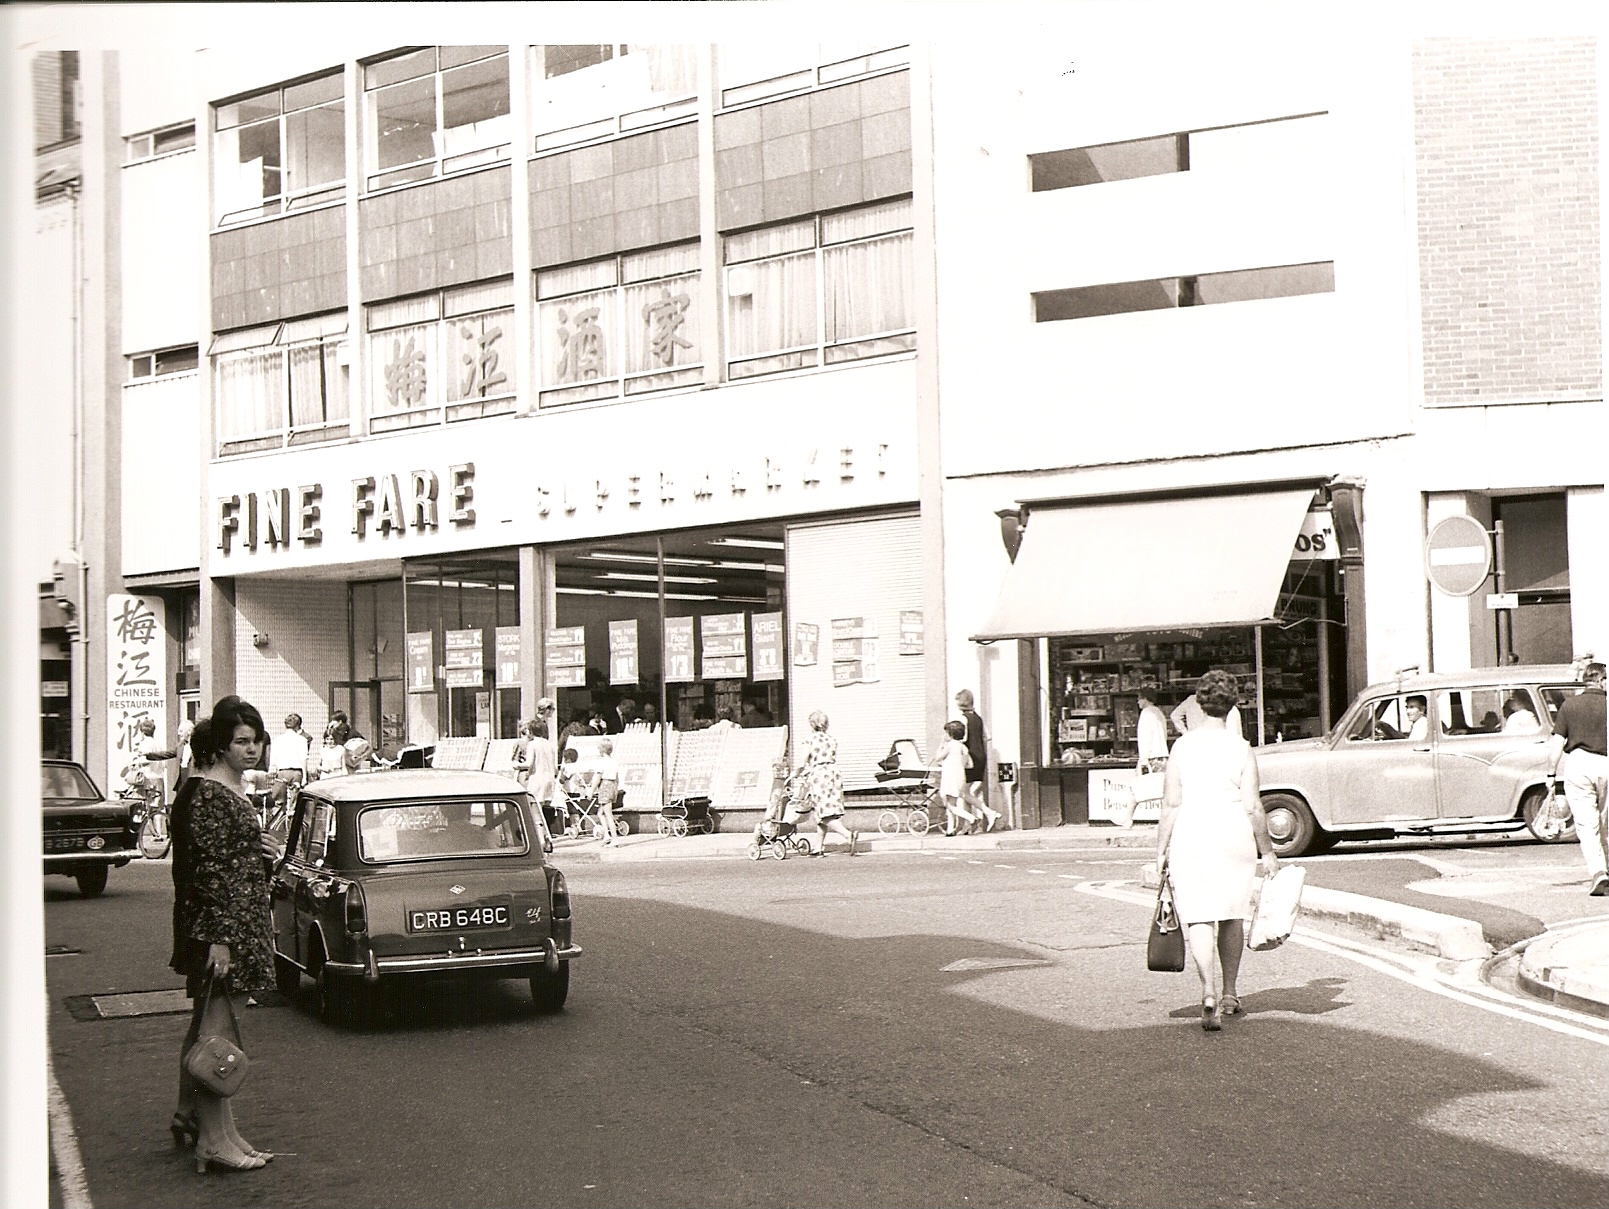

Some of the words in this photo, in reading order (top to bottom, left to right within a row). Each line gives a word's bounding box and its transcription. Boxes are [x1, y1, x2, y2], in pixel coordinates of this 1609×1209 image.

[217, 484, 323, 557] FINE
[351, 462, 476, 543] FARE
[753, 620, 781, 634] ARIEL
[498, 634, 520, 644] STORK
[754, 633, 775, 643] Giant
[114, 688, 160, 698] CHINESE
[109, 699, 164, 710] RESTAURANT
[91, 839, 102, 848] GB
[413, 911, 452, 930] CRB
[456, 907, 508, 927] 648C
